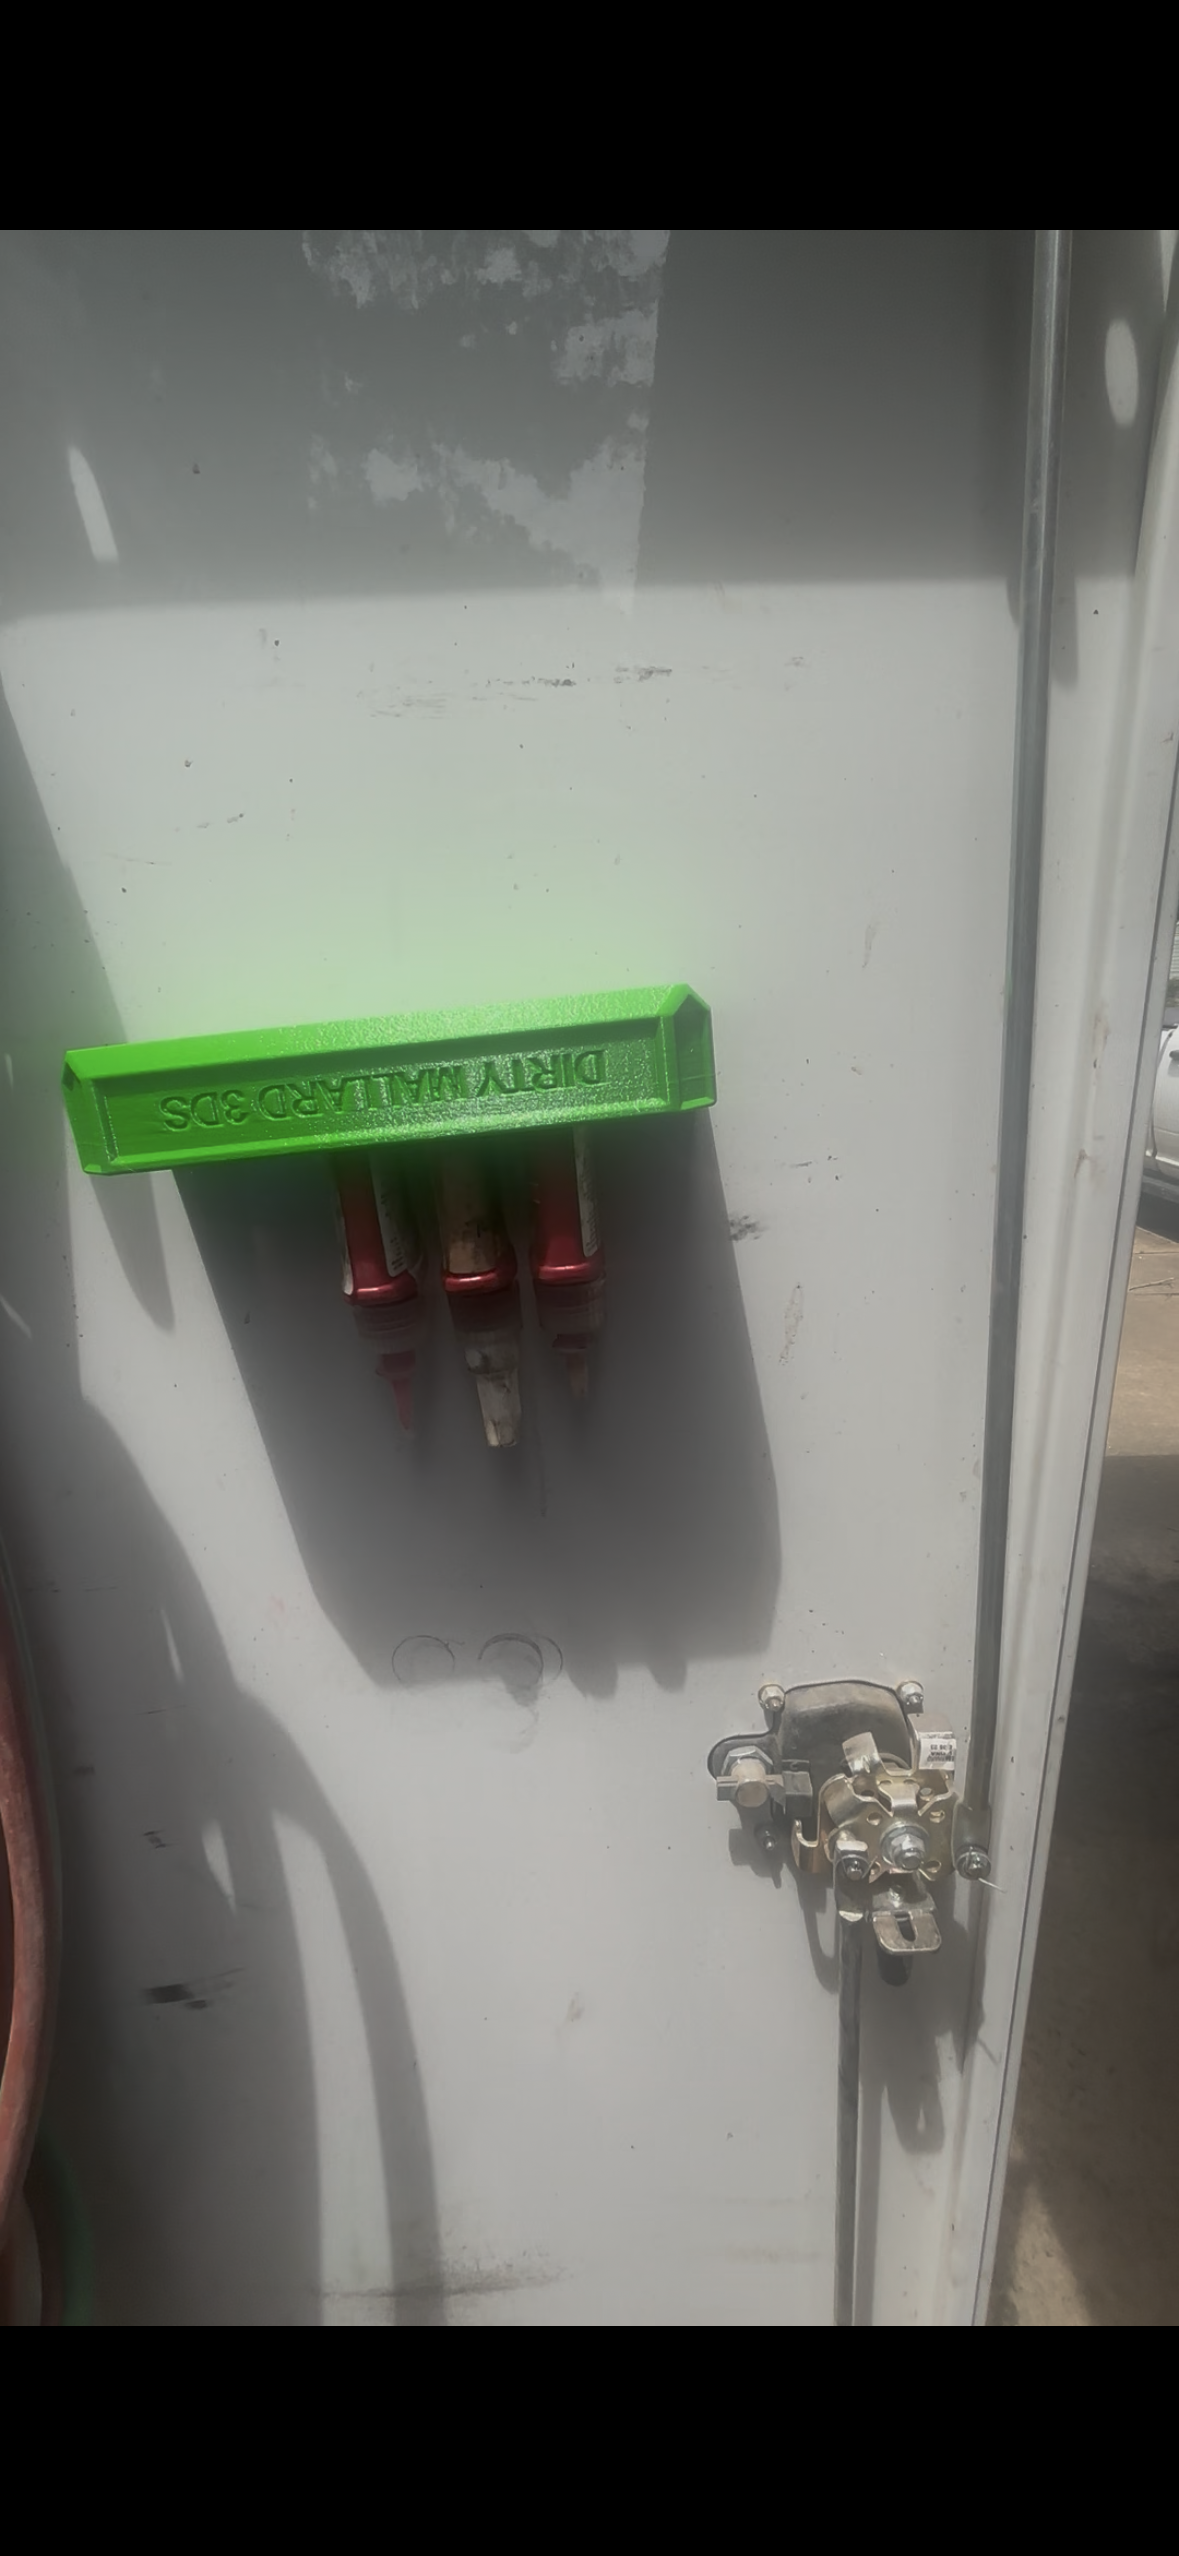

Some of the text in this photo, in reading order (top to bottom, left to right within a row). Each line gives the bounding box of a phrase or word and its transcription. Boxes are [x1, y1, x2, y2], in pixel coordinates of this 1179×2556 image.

[160, 1049, 609, 1132] DIRTY MALLARD 3DS
